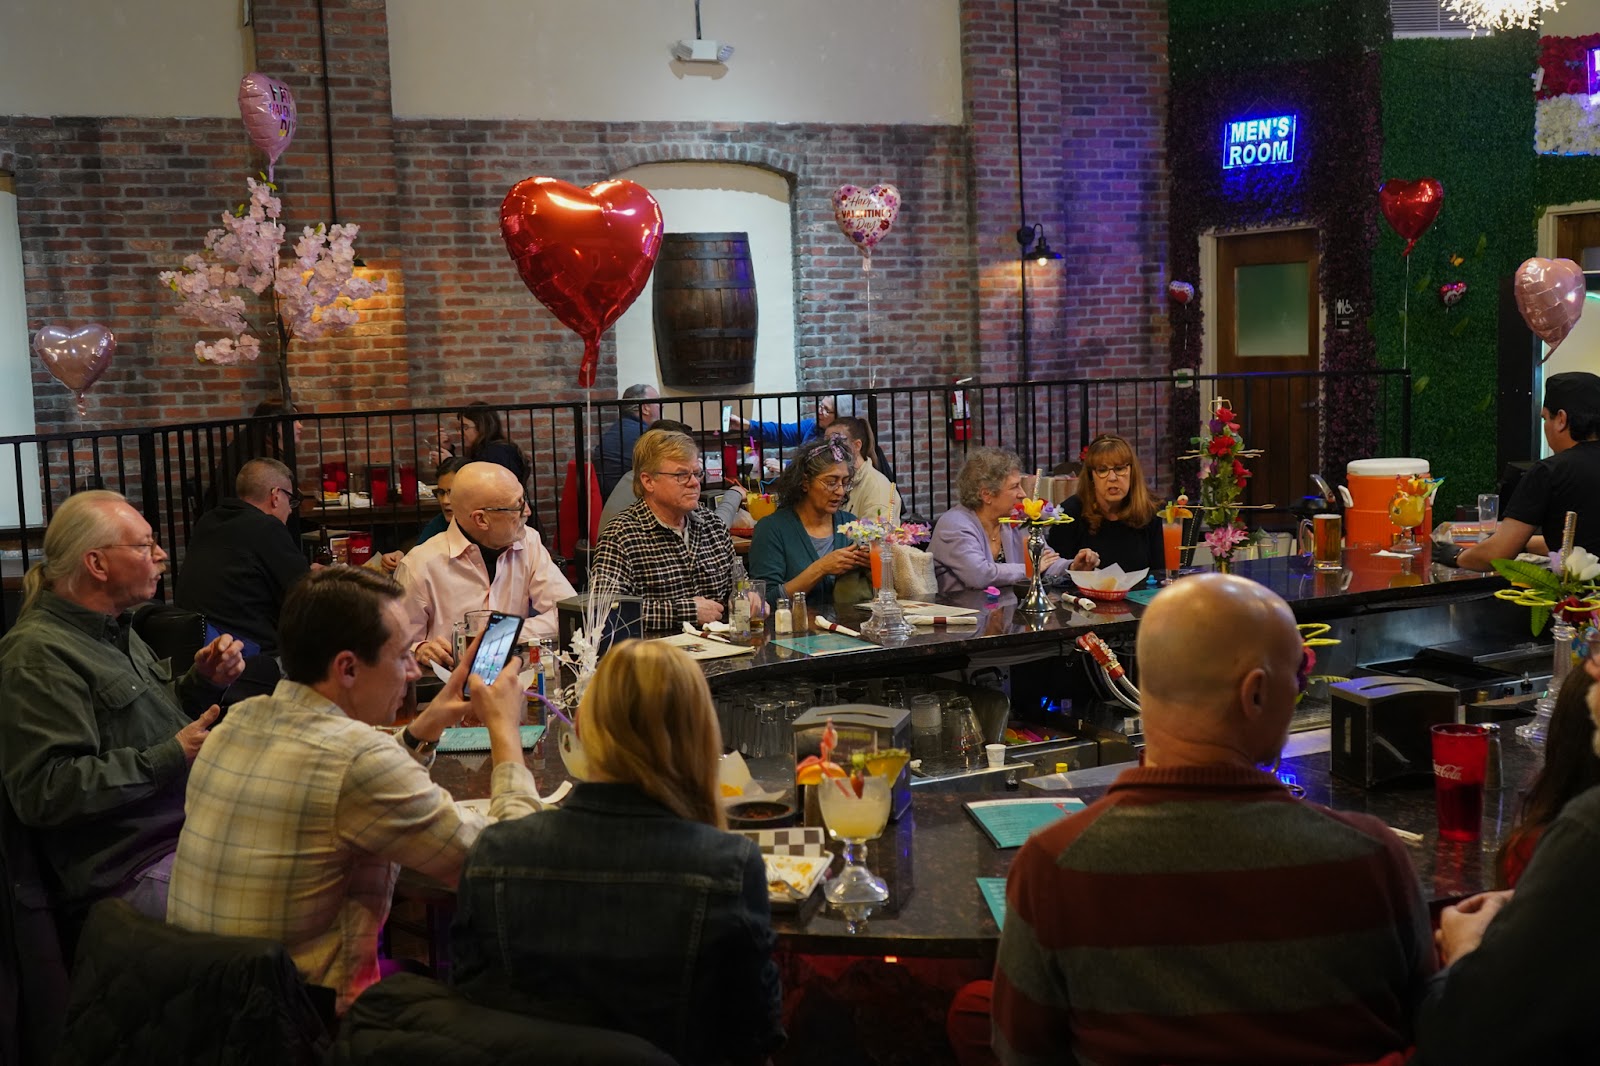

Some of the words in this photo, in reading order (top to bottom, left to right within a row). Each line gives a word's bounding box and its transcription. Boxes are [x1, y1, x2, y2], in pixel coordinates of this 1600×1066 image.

[1231, 117, 1289, 143] MEN'S
[1229, 140, 1288, 165] ROOM
[847, 195, 880, 208] Happ
[855, 218, 877, 232] Day
